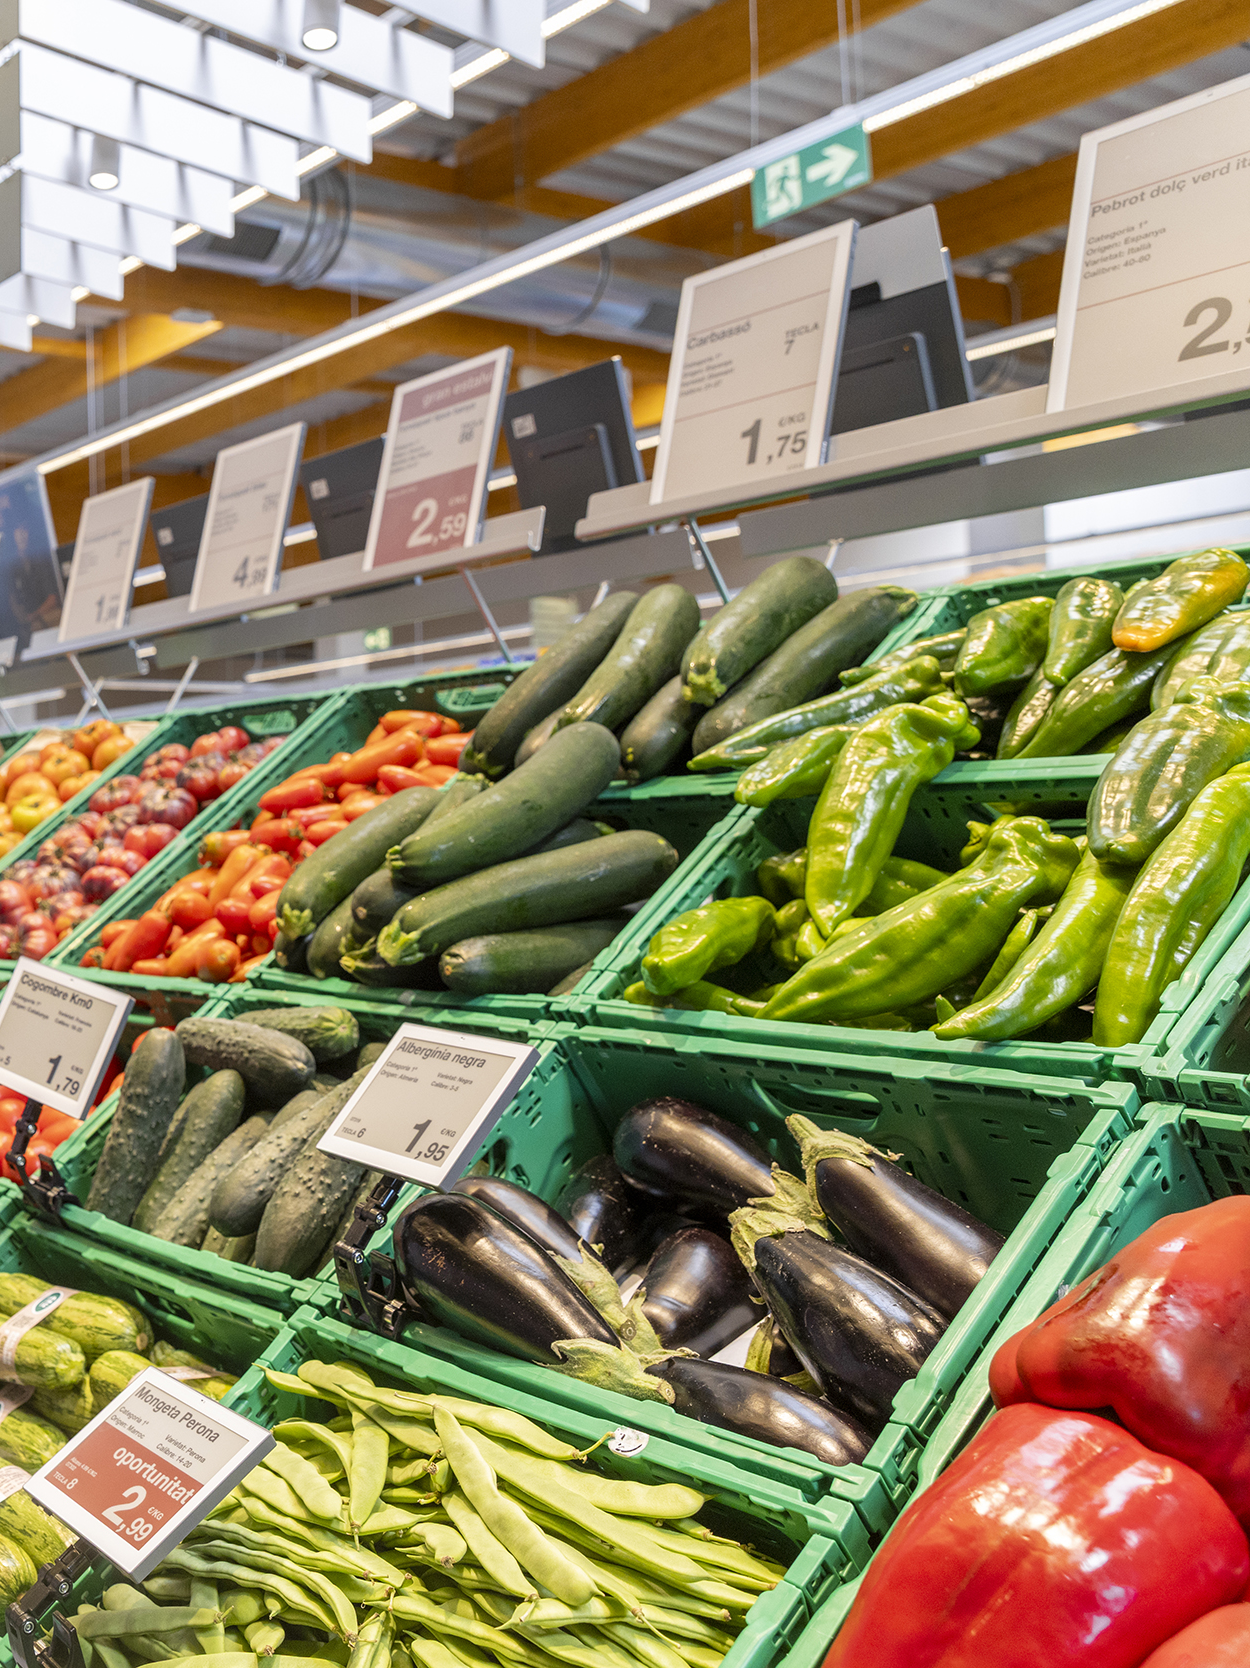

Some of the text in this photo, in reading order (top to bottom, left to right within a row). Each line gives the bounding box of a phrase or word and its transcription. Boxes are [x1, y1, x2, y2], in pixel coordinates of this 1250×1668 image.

[1090, 191, 1146, 218] Pebrot
[1150, 177, 1187, 200] dolç
[1191, 162, 1230, 185] verd
[687, 320, 751, 350] Carbassó
[785, 321, 819, 339] TECLA
[1177, 296, 1250, 362] 2,
[740, 417, 808, 466] 1,75
[406, 497, 467, 549] 2,59
[21, 974, 93, 1010] Cogombre Km0
[397, 1041, 487, 1069] Albergínia negra
[46, 1054, 80, 1096] 1,79
[357, 1128, 366, 1138] 6
[405, 1119, 450, 1161] 1,95
[440, 1128, 457, 1138] €/KG
[110, 1414, 145, 1440] Origen: Marroc
[119, 1406, 142, 1424] Categoria
[134, 1386, 220, 1443] Mongeta Perona
[156, 1443, 177, 1460] Calibre:
[165, 1434, 206, 1463] Varietat: Perona
[53, 1470, 69, 1485] TECLA
[66, 1478, 79, 1490] 8
[113, 1447, 195, 1505] oportunitat
[101, 1485, 154, 1542] 2,99
[147, 1506, 165, 1521] €/KG
